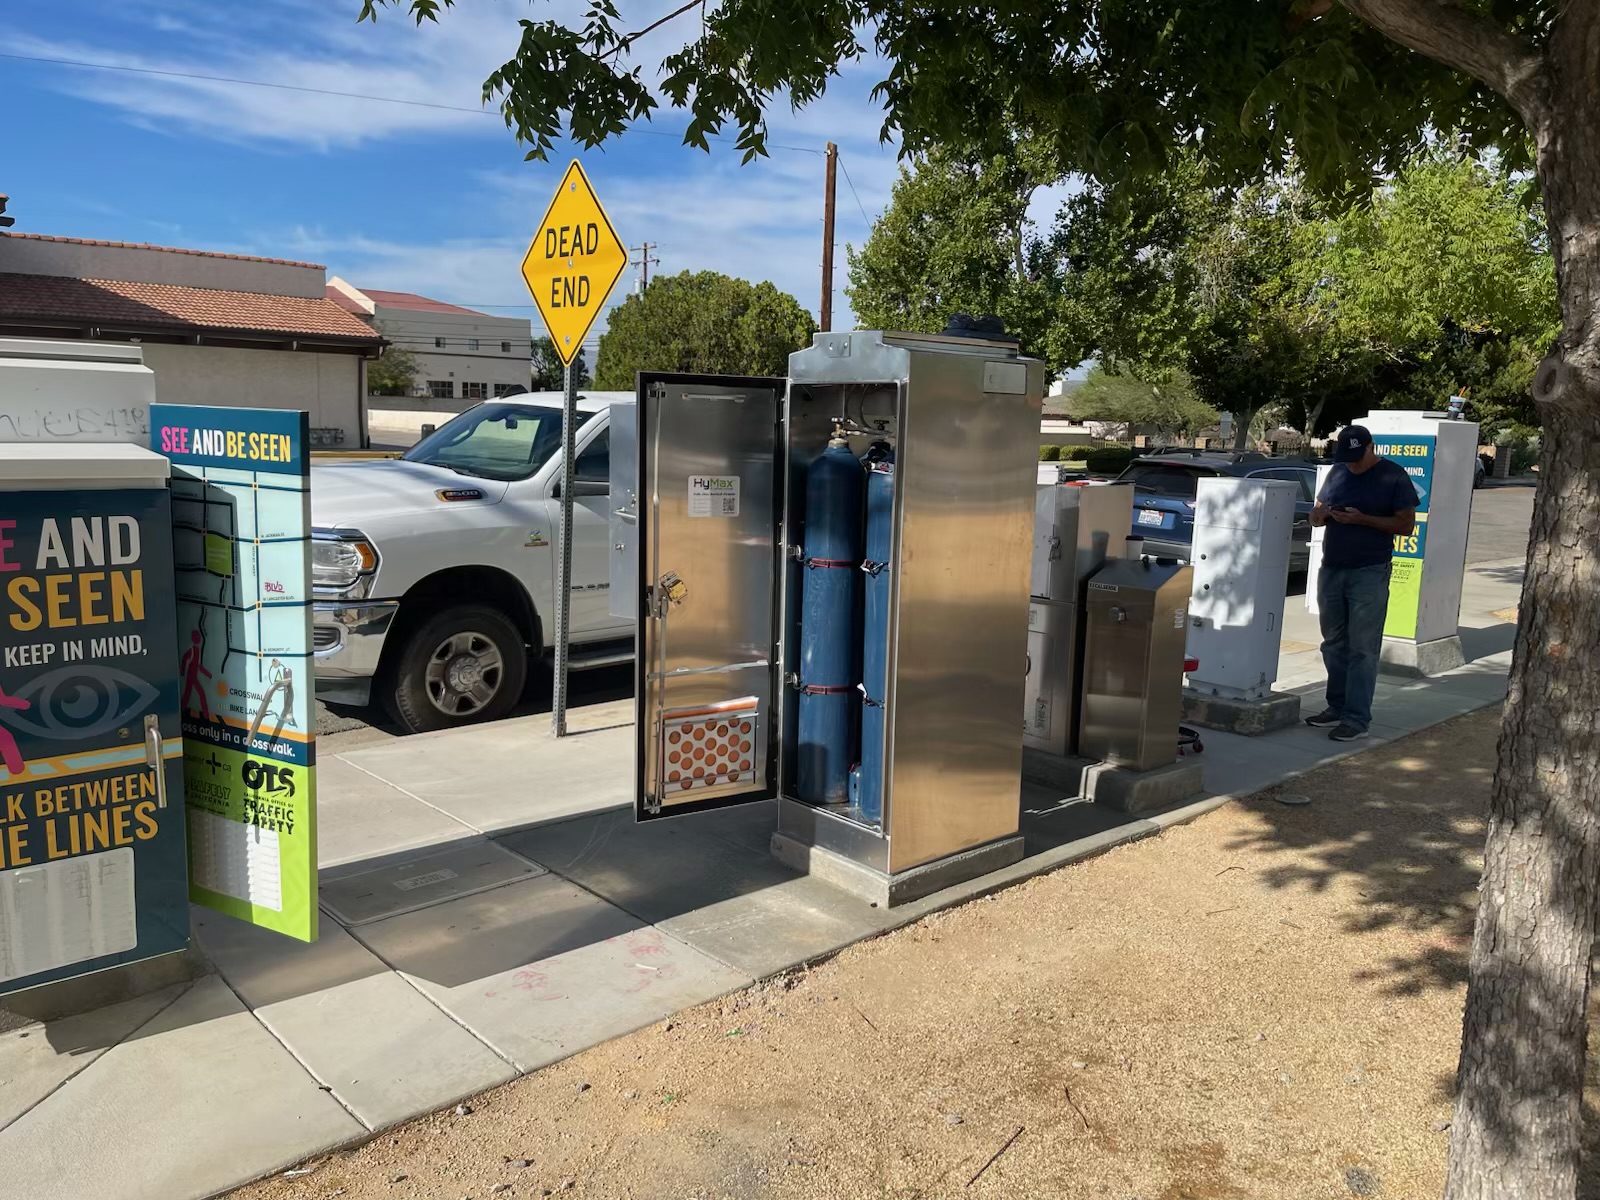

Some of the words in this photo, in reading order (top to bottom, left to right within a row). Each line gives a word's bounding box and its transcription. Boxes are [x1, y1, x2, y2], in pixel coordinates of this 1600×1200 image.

[545, 222, 599, 259] DEAD
[551, 275, 591, 308] END
[161, 426, 190, 454] SEE
[192, 428, 225, 457] AND
[226, 430, 247, 459] BE
[249, 432, 291, 463] SEEN
[1390, 444, 1402, 456] BE
[1403, 445, 1428, 457] SEEN
[693, 478, 733, 490] HyMax
[35, 515, 141, 570] AND
[7, 569, 145, 631] SEEN
[4, 643, 56, 668] KEEP
[62, 639, 84, 662] IN
[91, 634, 148, 657] MIND,
[229, 688, 272, 703] CROSSWAL
[229, 704, 244, 713] BIKE
[245, 707, 258, 716] LAN
[199, 726, 220, 741] only
[222, 728, 231, 741] in
[233, 735, 240, 744] a
[242, 737, 296, 757] cosswalk.
[35, 770, 156, 818] BETWEEN
[242, 760, 296, 797] OTS
[243, 798, 294, 822] TRAFFIC
[271, 799, 286, 807] OFFICE
[45, 801, 159, 860] LINES
[243, 812, 295, 835] SAFETY
